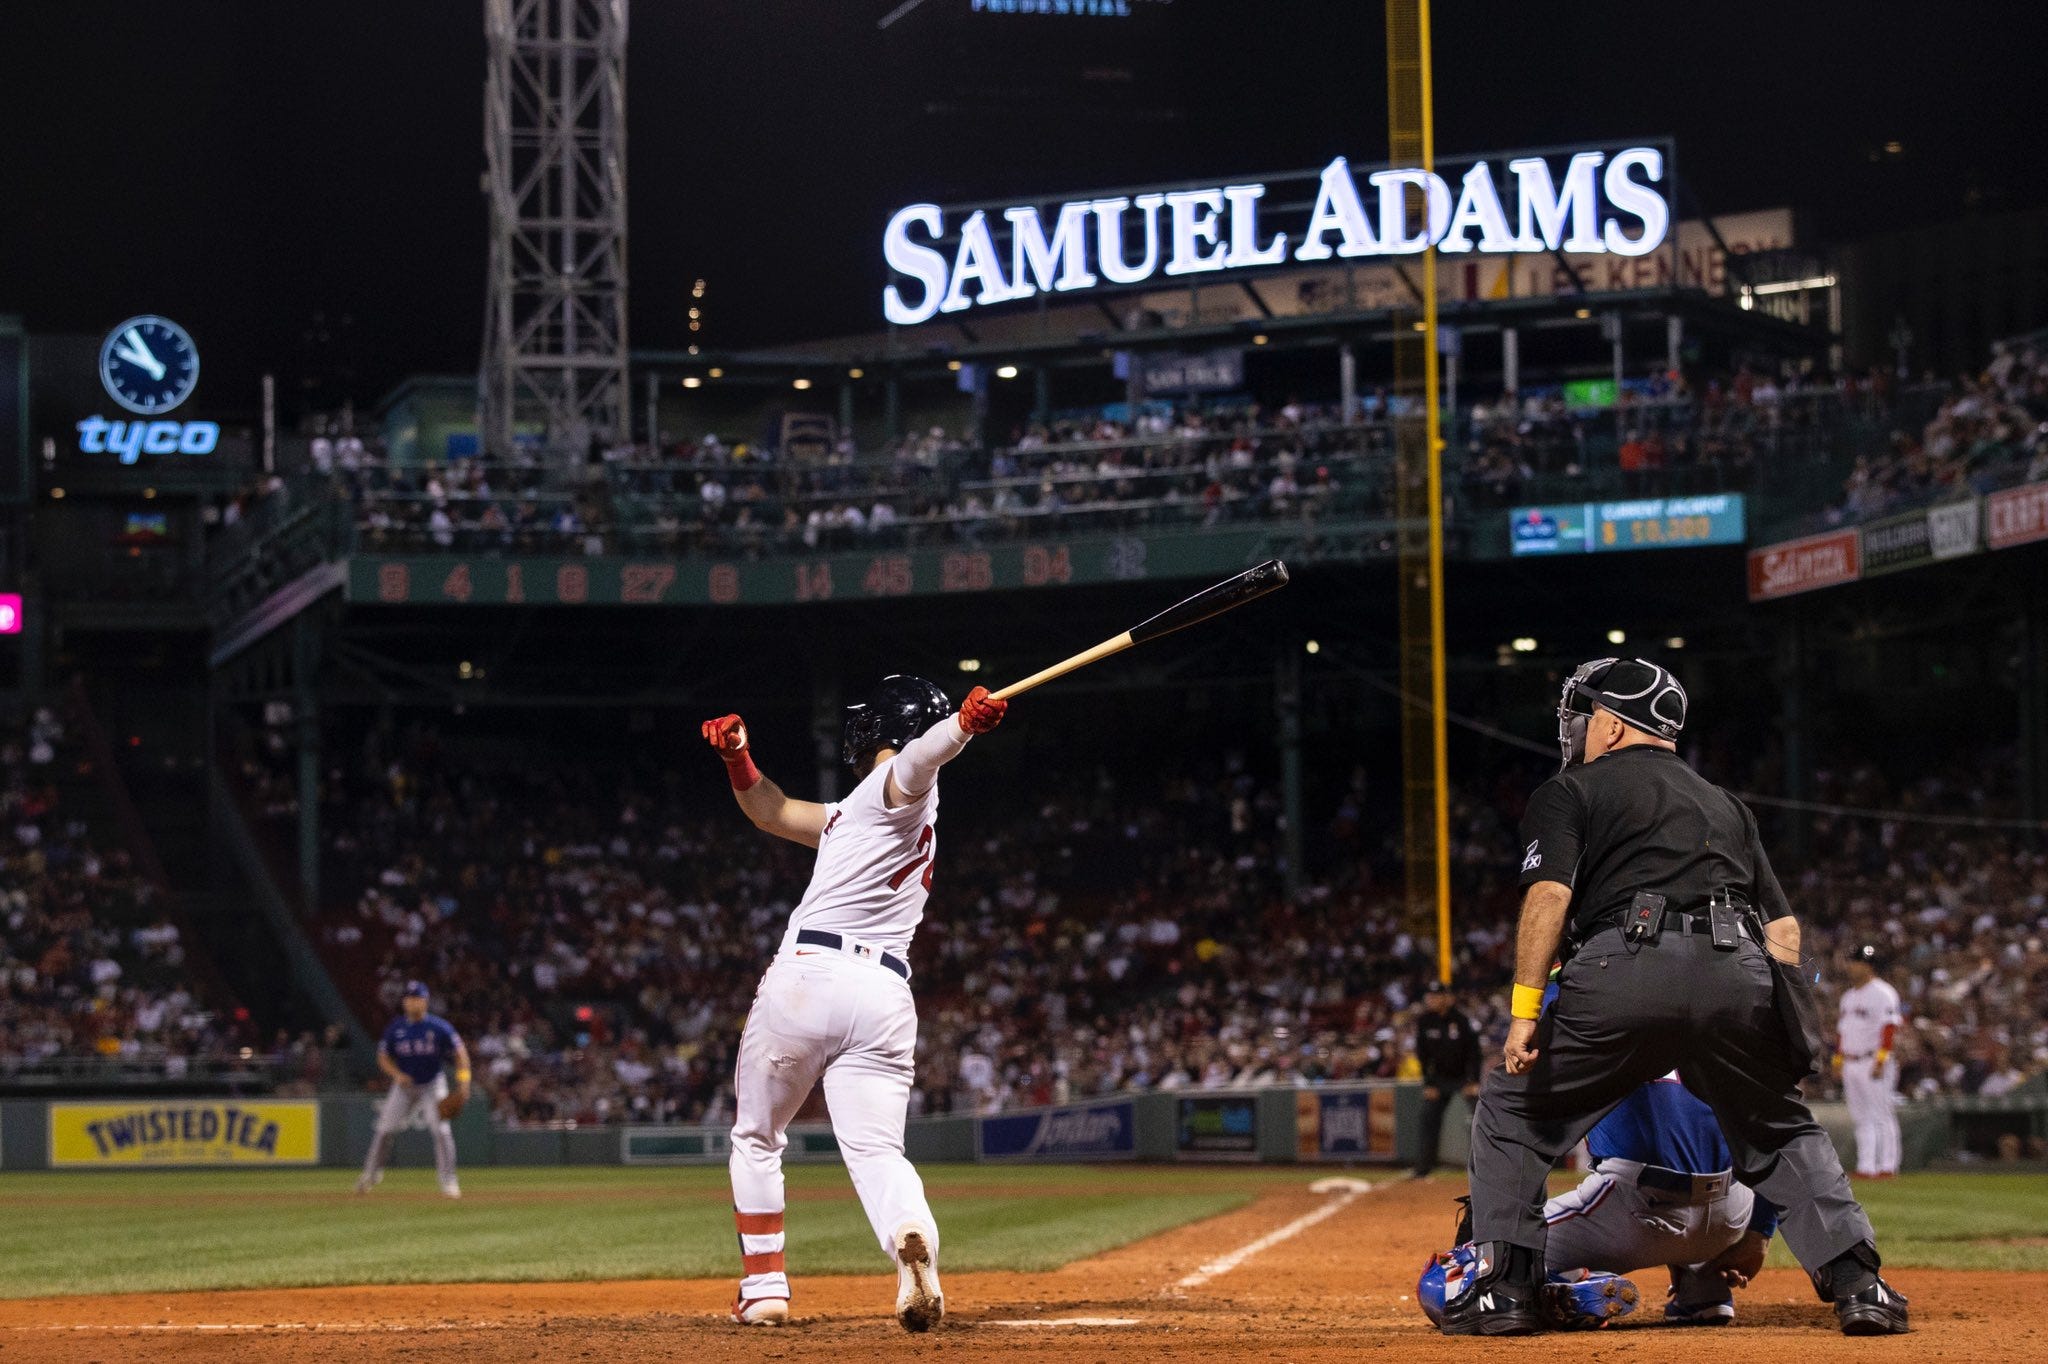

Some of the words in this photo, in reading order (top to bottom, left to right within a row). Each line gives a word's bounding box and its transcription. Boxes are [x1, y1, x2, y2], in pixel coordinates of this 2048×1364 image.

[883, 184, 1287, 325] SAMUEL
[1295, 147, 1670, 257] ADAMS
[76, 414, 221, 465] tyco
[443, 563, 473, 602] 4
[506, 563, 524, 602] 1
[87, 1109, 219, 1157] TWISTED
[224, 1108, 281, 1156] TEA
[1479, 1291, 1496, 1312] N
